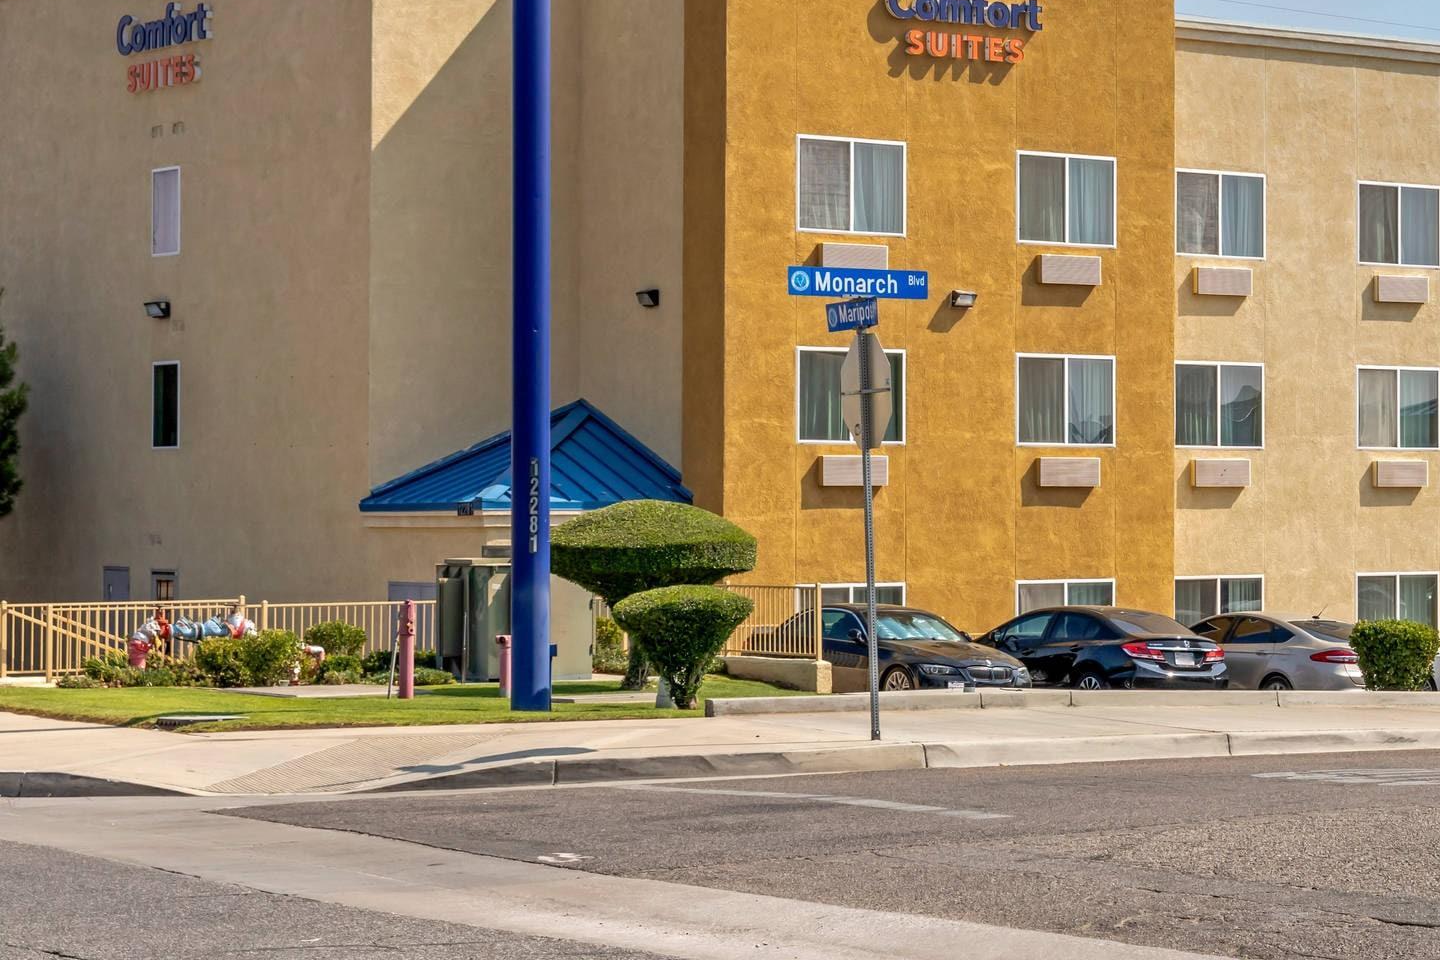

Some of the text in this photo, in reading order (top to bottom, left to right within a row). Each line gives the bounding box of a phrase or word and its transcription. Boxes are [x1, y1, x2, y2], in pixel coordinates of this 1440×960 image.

[116, 1, 210, 56] Comfort
[905, 29, 1025, 64] SUITES
[127, 54, 199, 94] SUITES
[815, 271, 925, 294] Monarch Blvd
